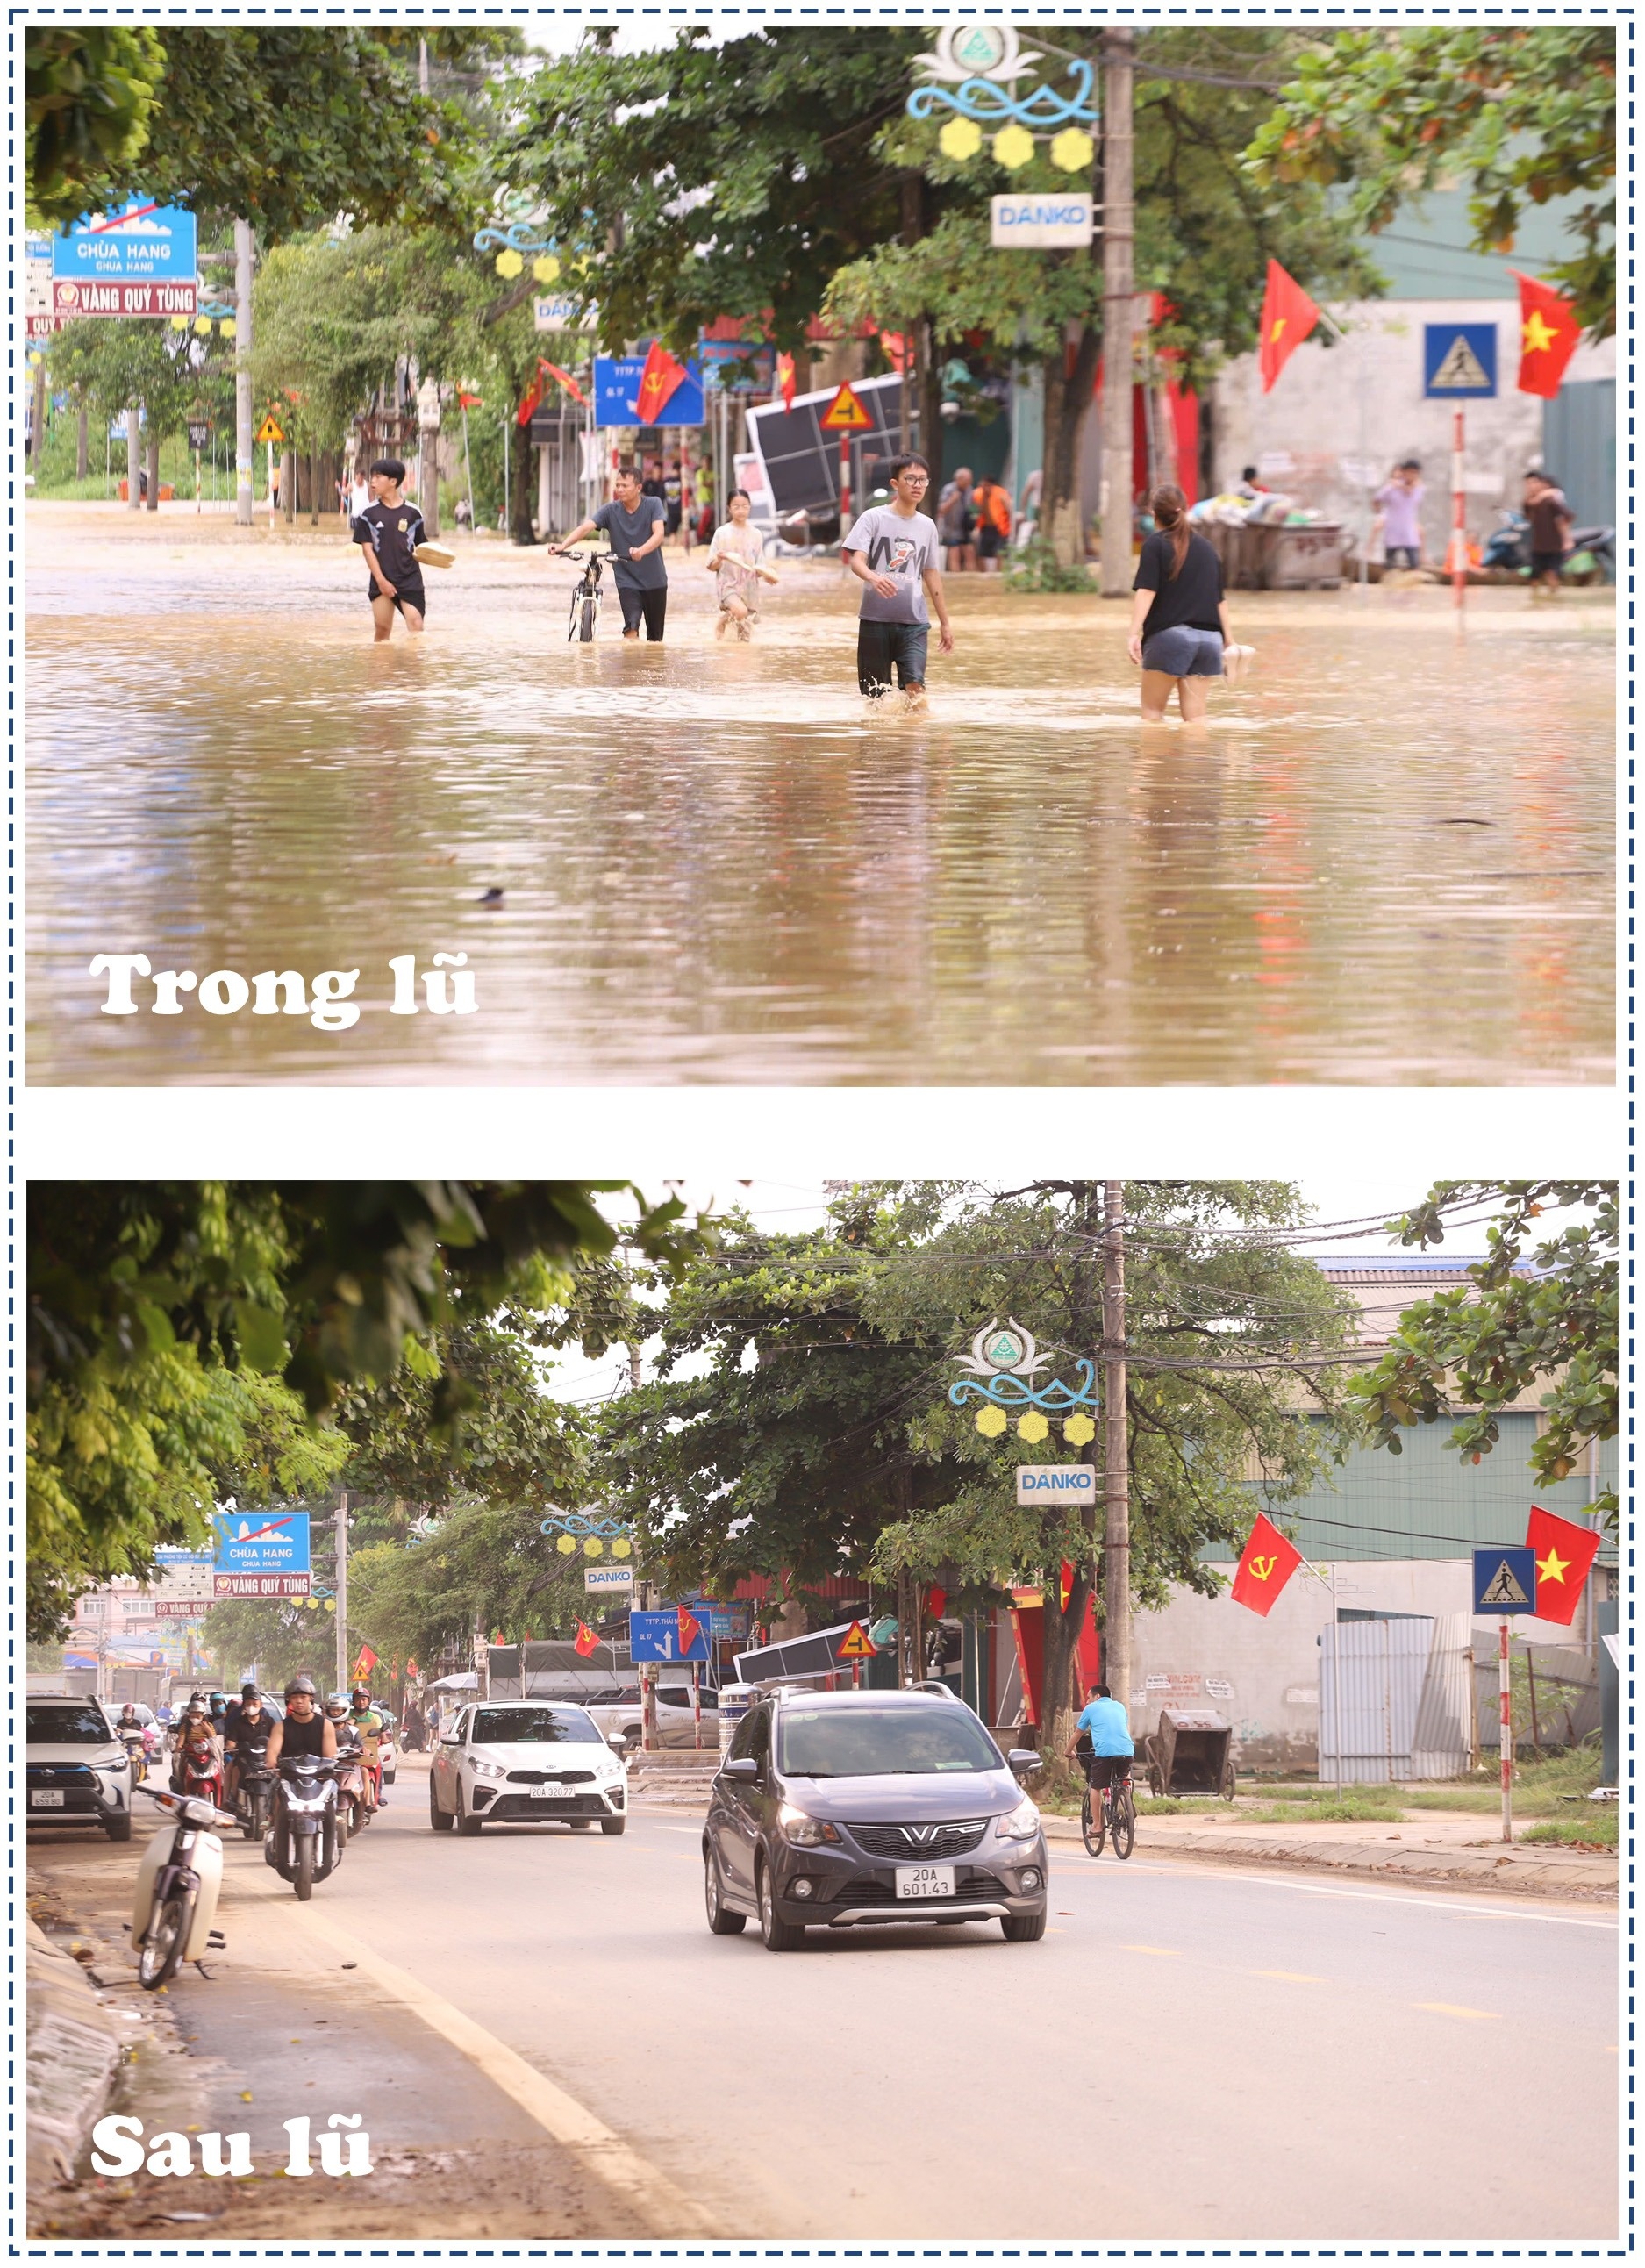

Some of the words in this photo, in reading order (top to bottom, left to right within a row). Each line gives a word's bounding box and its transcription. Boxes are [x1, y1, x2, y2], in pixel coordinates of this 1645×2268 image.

[999, 206, 1086, 225] DANKO
[127, 244, 171, 259] HANG
[96, 261, 122, 273] CHUA
[126, 261, 154, 273] HANG
[81, 283, 120, 311] VÀNG
[125, 283, 152, 313] QUÝ
[156, 283, 194, 312] TÙNG
[1022, 1473, 1091, 1490] DANKO
[229, 1547, 259, 1558] CHÙA
[263, 1549, 293, 1558] HANG
[588, 1571, 631, 1584] DANKO
[232, 1576, 259, 1593] VÀNG
[261, 1576, 280, 1595] QUÝ
[283, 1576, 308, 1593] TÙNG
[169, 1602, 190, 1613] VÀNG
[913, 1869, 937, 1881] 20A
[903, 1882, 948, 1896] 601.43
